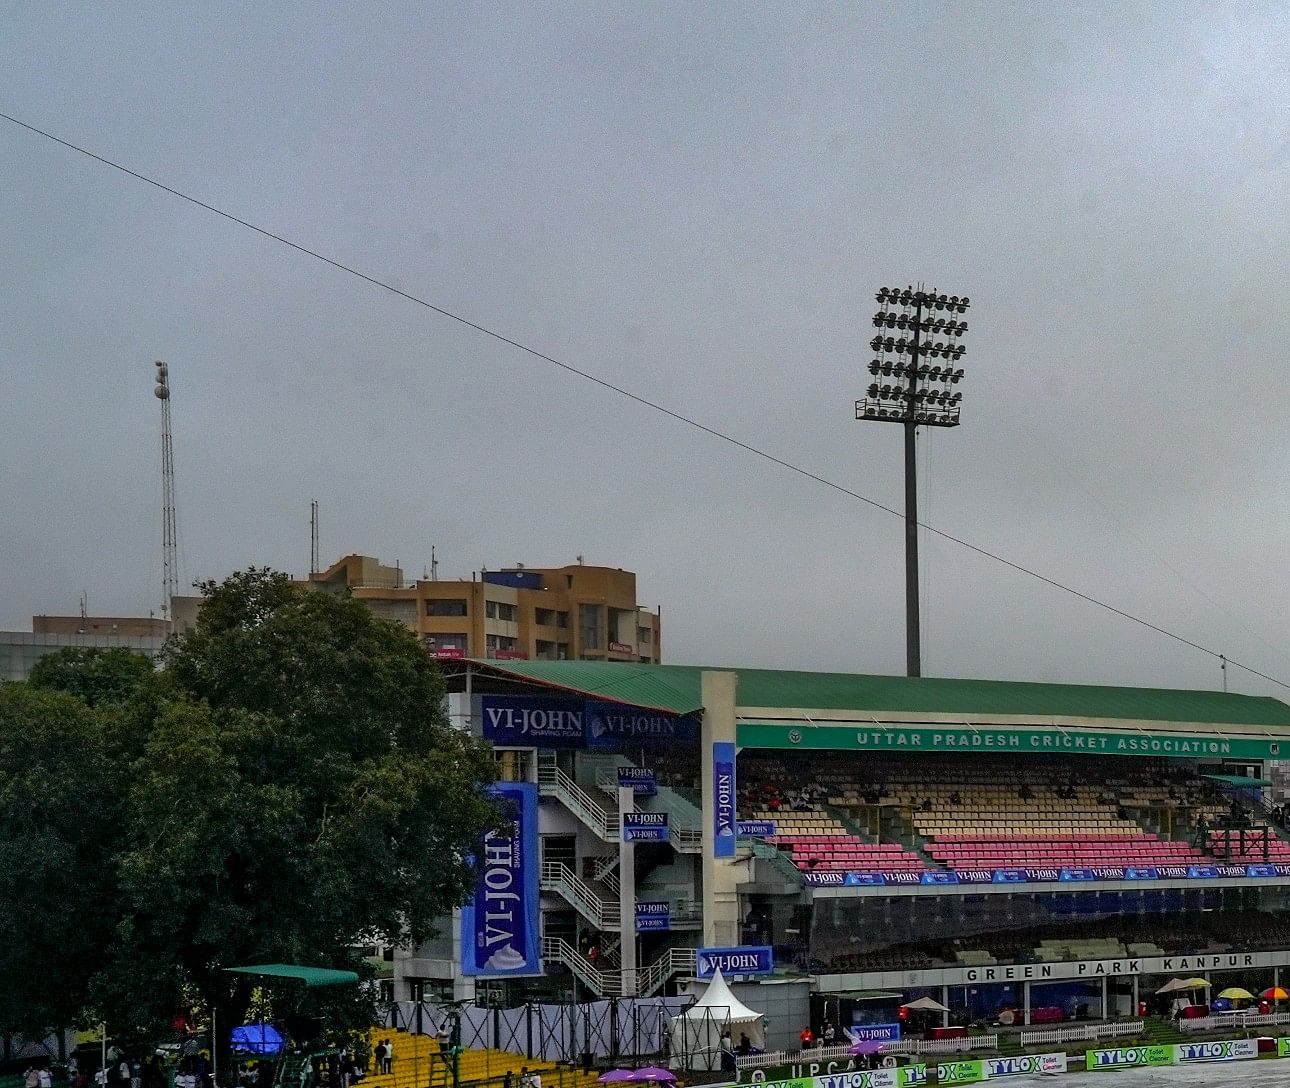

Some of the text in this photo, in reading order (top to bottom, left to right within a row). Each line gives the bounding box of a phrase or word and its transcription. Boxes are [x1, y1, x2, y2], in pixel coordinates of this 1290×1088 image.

[485, 708, 583, 733] VI-JOHN
[857, 733, 1232, 754] UTTAR PRADESH CRICKET ASSOCIATION
[718, 774, 733, 827] VI-JOHN
[627, 814, 664, 825] VI-JOHN
[806, 871, 843, 885] VI-JOHN
[883, 871, 920, 884] VI-JOHN
[956, 869, 992, 882] VI-JOHN
[1156, 867, 1188, 878] VI-JOHN
[638, 904, 668, 914] VI-JOHN
[708, 954, 758, 971] VI-JOHN
[967, 955, 1253, 981] GREEN PARK KANPUR
[859, 1028, 891, 1041] VI-JOHN
